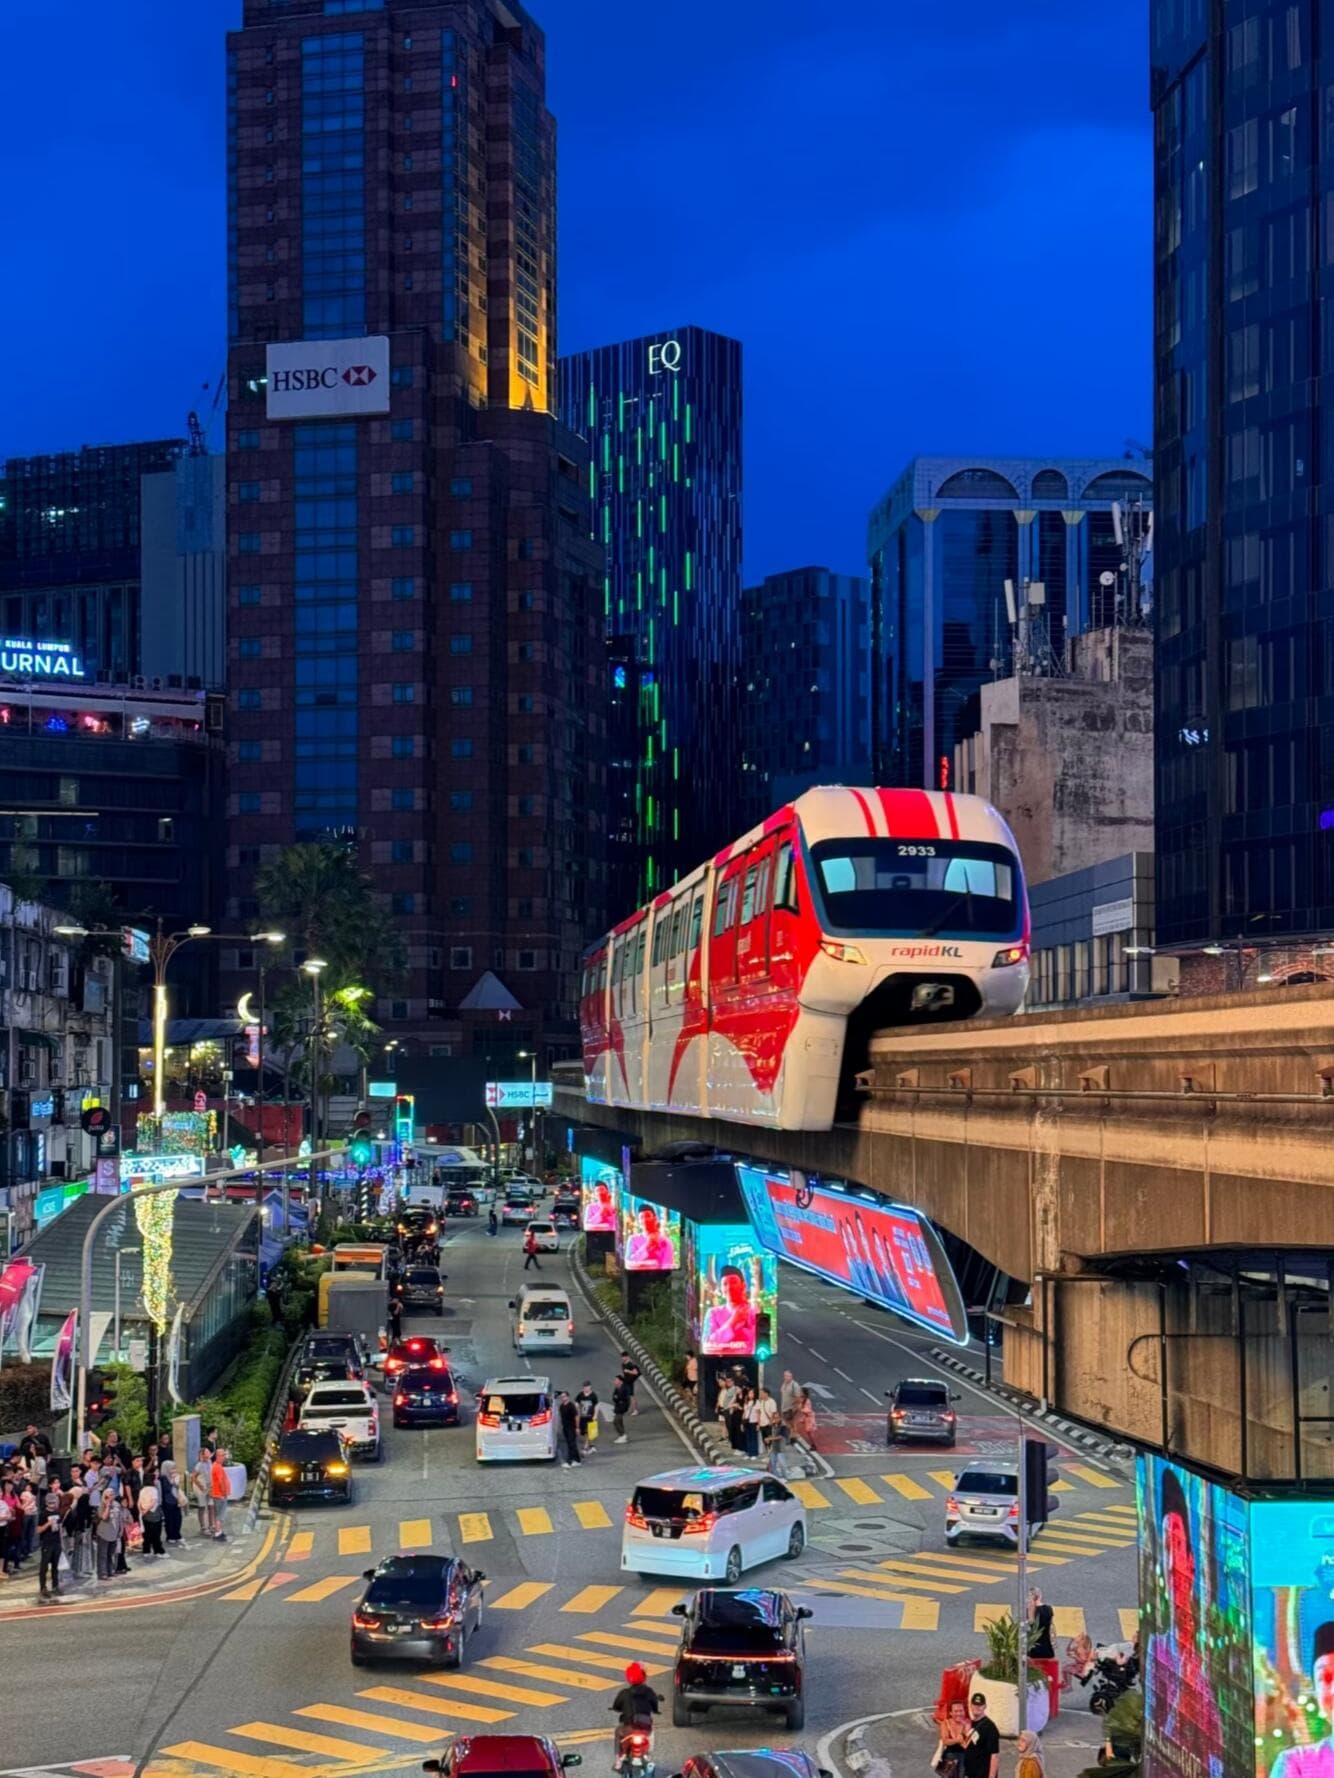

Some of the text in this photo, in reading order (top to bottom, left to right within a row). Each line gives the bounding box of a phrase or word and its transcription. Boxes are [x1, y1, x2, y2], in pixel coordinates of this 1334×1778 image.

[649, 341, 681, 375] EQ
[273, 368, 338, 392] HSBC
[897, 845, 936, 857] 2933
[891, 945, 963, 958] rapidKL
[507, 1090, 529, 1099] HSBC
